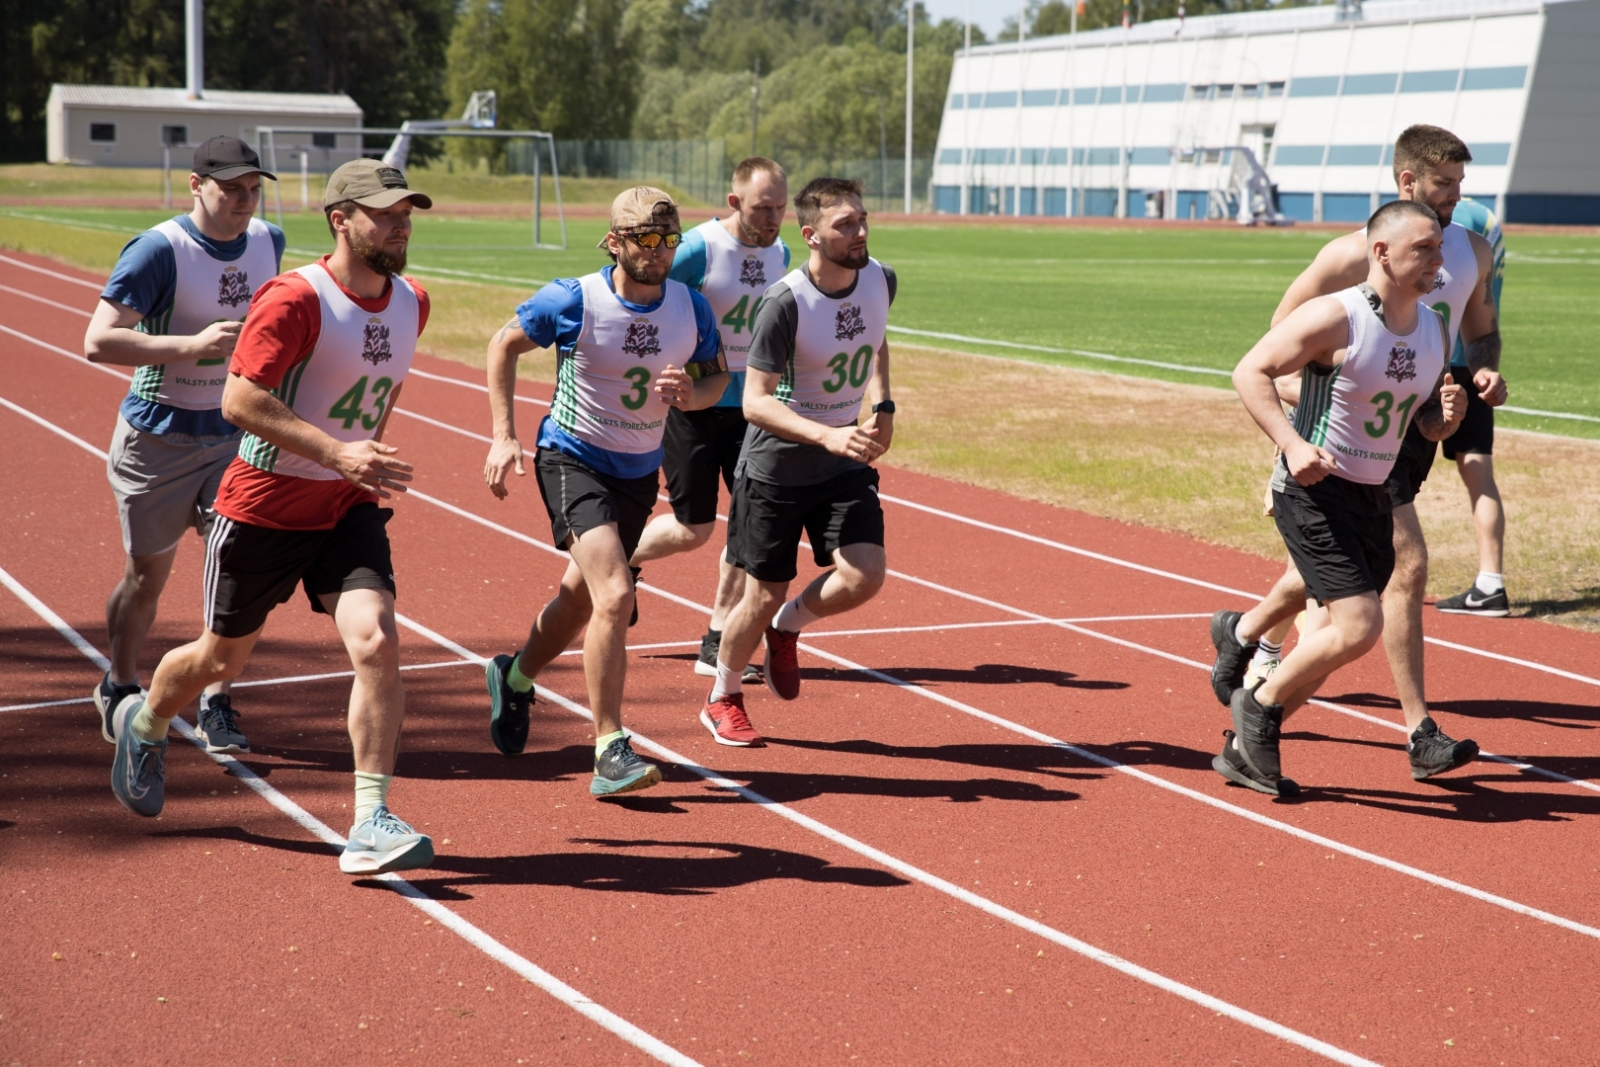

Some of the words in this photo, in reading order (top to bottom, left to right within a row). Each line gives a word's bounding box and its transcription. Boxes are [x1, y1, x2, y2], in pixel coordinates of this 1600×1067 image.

[175, 376, 207, 387] VALSTS
[620, 366, 652, 411] 3
[821, 344, 873, 394] 30
[327, 375, 393, 431] 43
[800, 402, 829, 410] VALSTS
[1363, 390, 1419, 440] 31
[1337, 444, 1369, 459] VALSTS
[1369, 451, 1398, 461] ROBEŽS
